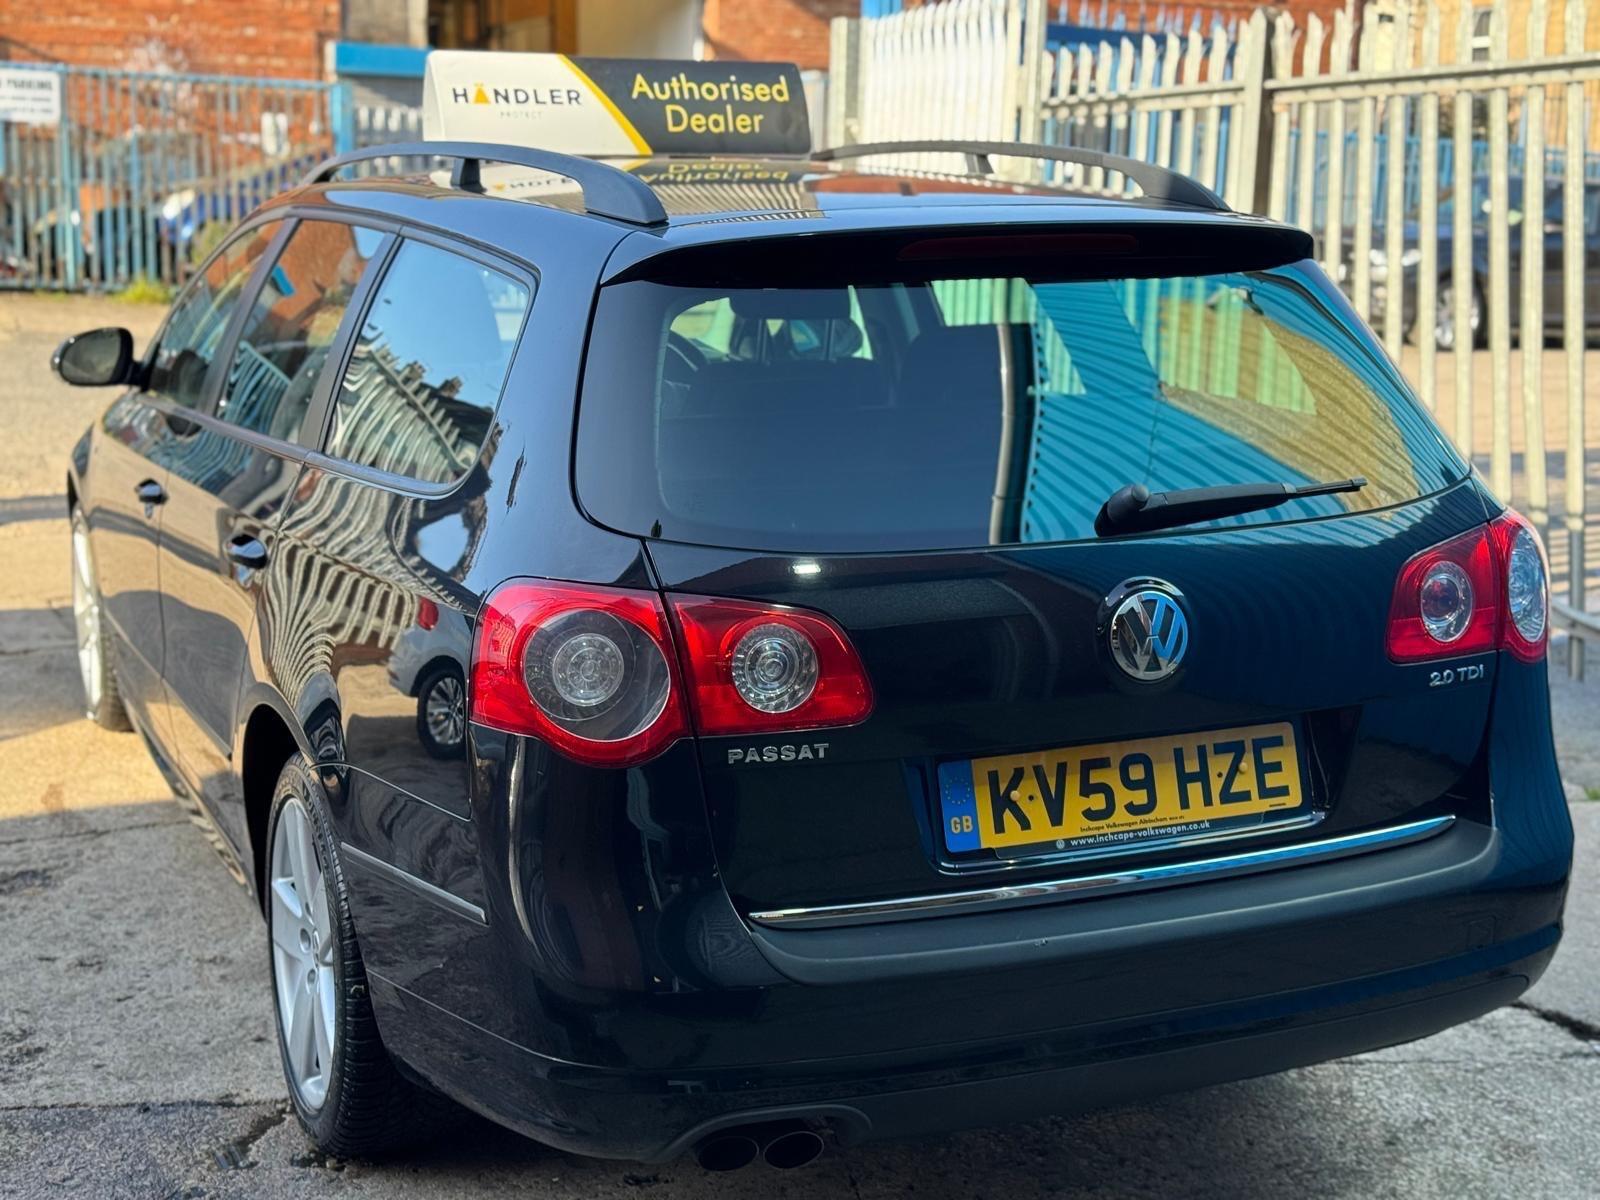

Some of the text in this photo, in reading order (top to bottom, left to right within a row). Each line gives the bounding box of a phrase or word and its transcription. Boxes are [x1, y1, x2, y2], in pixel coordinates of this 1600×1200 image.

[631, 72, 789, 102] Authorised
[500, 111, 543, 119] PROTECT
[665, 104, 764, 133] Dealer
[1456, 664, 1484, 682] TDI
[727, 743, 829, 764] PASSAT
[987, 735, 1290, 834] KV59 HZE
[950, 815, 973, 834] GB
[1070, 820, 1210, 846] www.inchcape-volkswagen.co.uk
